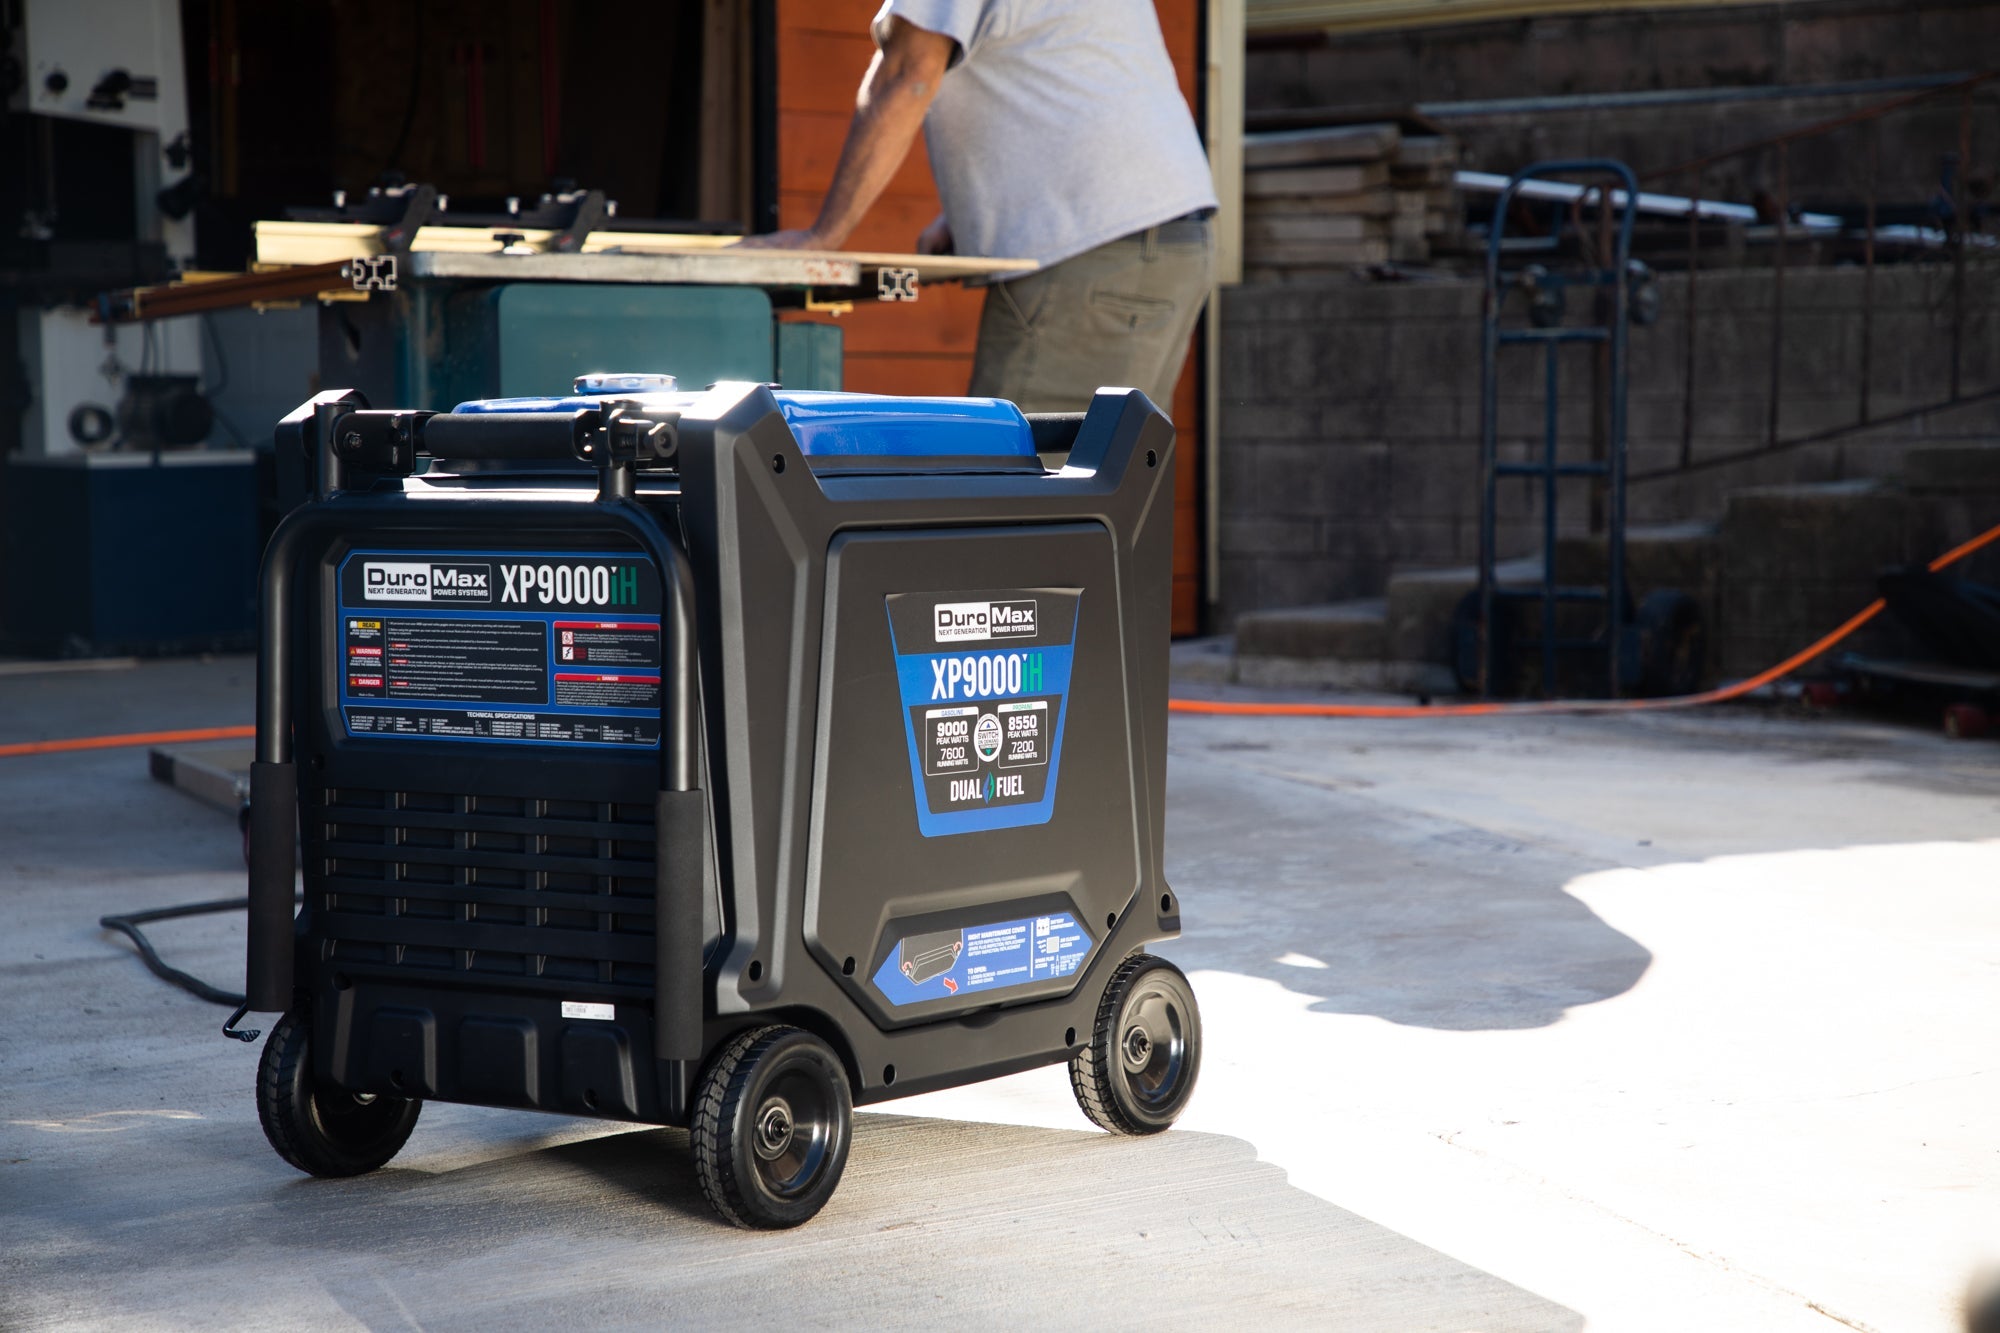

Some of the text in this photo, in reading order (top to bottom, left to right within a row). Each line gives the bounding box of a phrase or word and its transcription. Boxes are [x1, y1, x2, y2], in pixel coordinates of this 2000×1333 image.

[434, 588, 488, 597] POWER SYSTEMS
[500, 564, 637, 605] XP9000iH
[931, 653, 1043, 700] XP9000iH
[937, 721, 968, 737] 9000
[1008, 715, 1037, 730] 8550
[940, 747, 964, 760] 7600
[1011, 740, 1034, 753] 7200
[951, 780, 982, 801] DUAL
[996, 775, 1024, 797] FUEL
